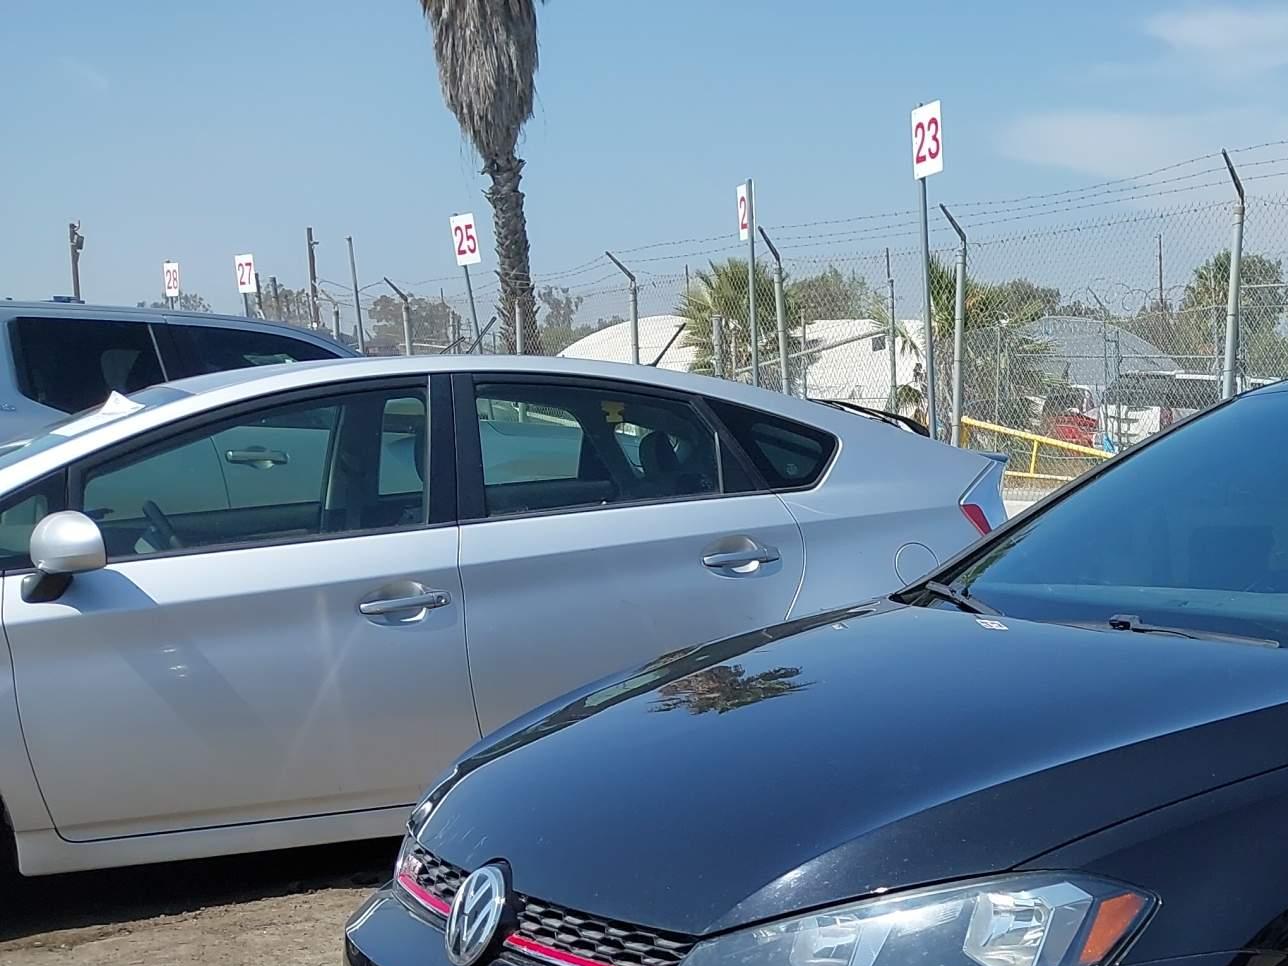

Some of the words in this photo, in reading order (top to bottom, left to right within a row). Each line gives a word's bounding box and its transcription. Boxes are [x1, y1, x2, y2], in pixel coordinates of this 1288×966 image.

[915, 117, 940, 164] 23
[739, 196, 748, 230] 2
[454, 224, 476, 255] 25
[165, 269, 178, 289] 28
[237, 262, 252, 285] 27
